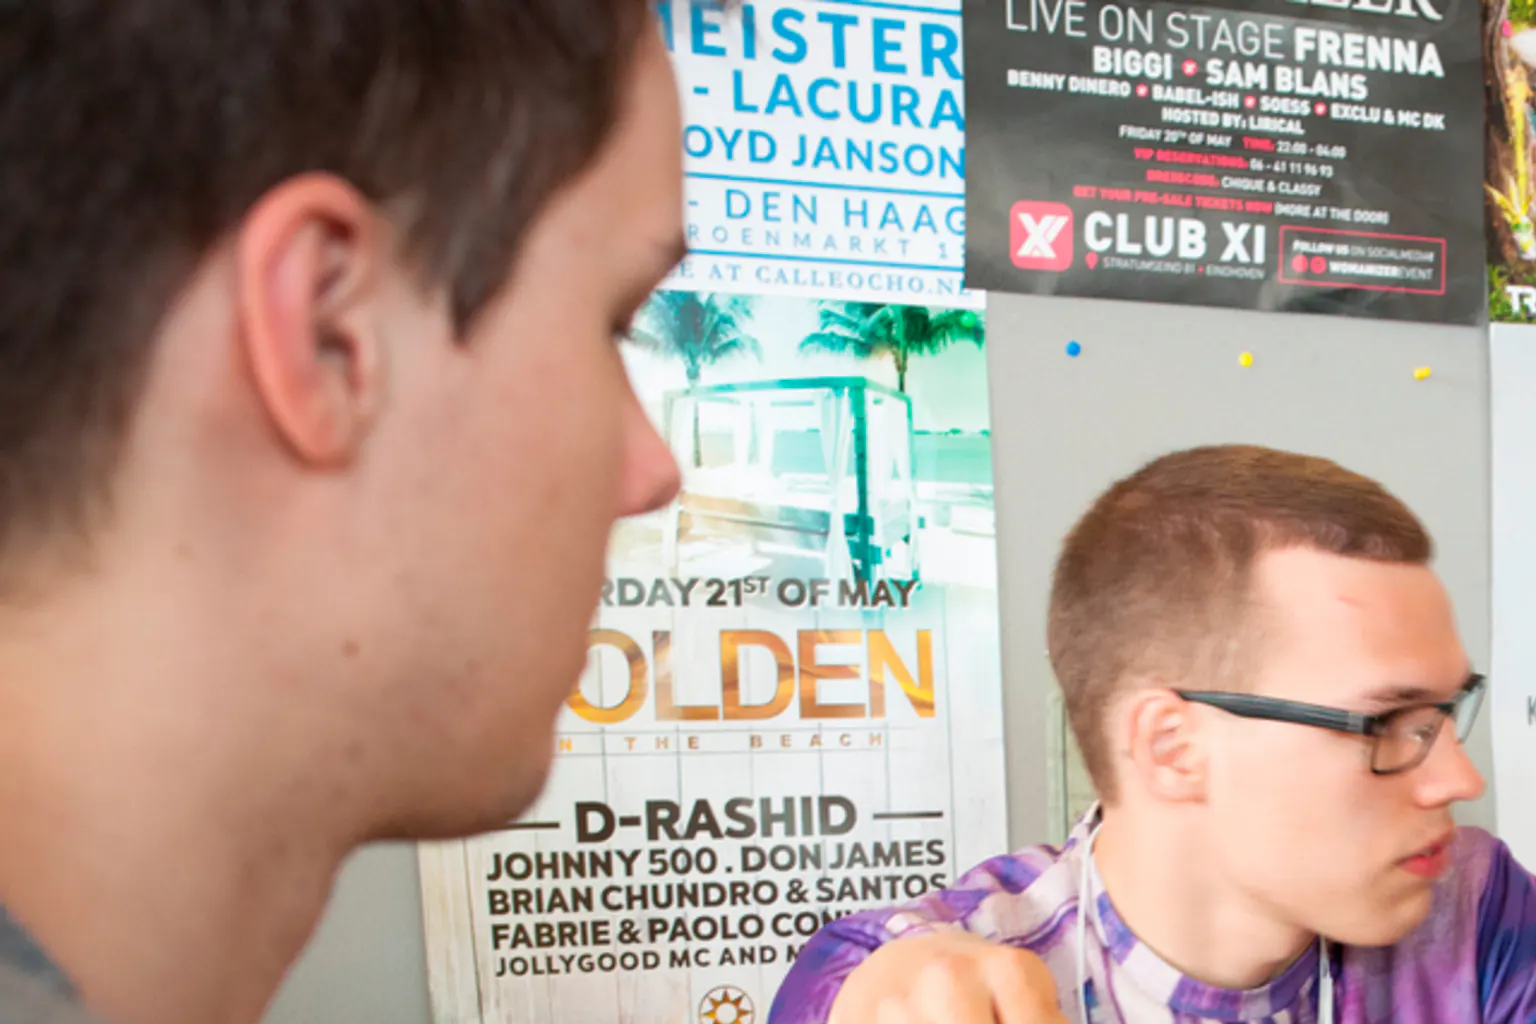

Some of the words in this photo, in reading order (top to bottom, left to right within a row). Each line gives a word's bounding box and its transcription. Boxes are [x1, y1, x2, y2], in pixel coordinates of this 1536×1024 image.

[1006, 0, 1087, 37] LIVE
[1099, 4, 1154, 44] ON
[1166, 12, 1285, 59] STAGE
[1294, 27, 1444, 78] FRENNA
[1093, 46, 1172, 80] BIGGI
[1206, 58, 1268, 90] SAM
[1275, 65, 1368, 100] BLANS
[733, 69, 965, 131] LACURA
[1007, 69, 1066, 91] BENNY
[1068, 75, 1132, 98] DINERO
[1383, 108, 1395, 125] &
[1397, 110, 1421, 128] MC
[1161, 106, 1220, 126] HOSTED
[792, 134, 965, 180] JANSON
[725, 189, 817, 225] DEN
[844, 198, 965, 236] HAAG
[1084, 210, 1207, 260] CLUB
[1219, 221, 1266, 265] XI
[708, 263, 742, 281] AT
[755, 265, 972, 296] CALLEOCHO.NL
[777, 577, 830, 608] OF
[839, 578, 918, 608] MAY
[565, 628, 936, 724] OLDEN
[624, 735, 700, 751] THE
[750, 732, 882, 750] BEACH
[575, 795, 857, 843] D-RASHID
[487, 849, 642, 881] JOHNNY
[649, 846, 718, 876] 500
[741, 843, 822, 873] DON
[829, 839, 946, 870] JAMES
[488, 886, 594, 916] BRIAN
[601, 880, 778, 911] CHUNDRO
[785, 878, 809, 903] &
[816, 873, 947, 903] SANTOS
[491, 920, 611, 950] FABRIE
[617, 918, 641, 945] &
[648, 913, 765, 944] PAOLO
[496, 950, 660, 977] JOLLYGOOD
[669, 949, 711, 969] MC
[719, 945, 777, 966] AND
